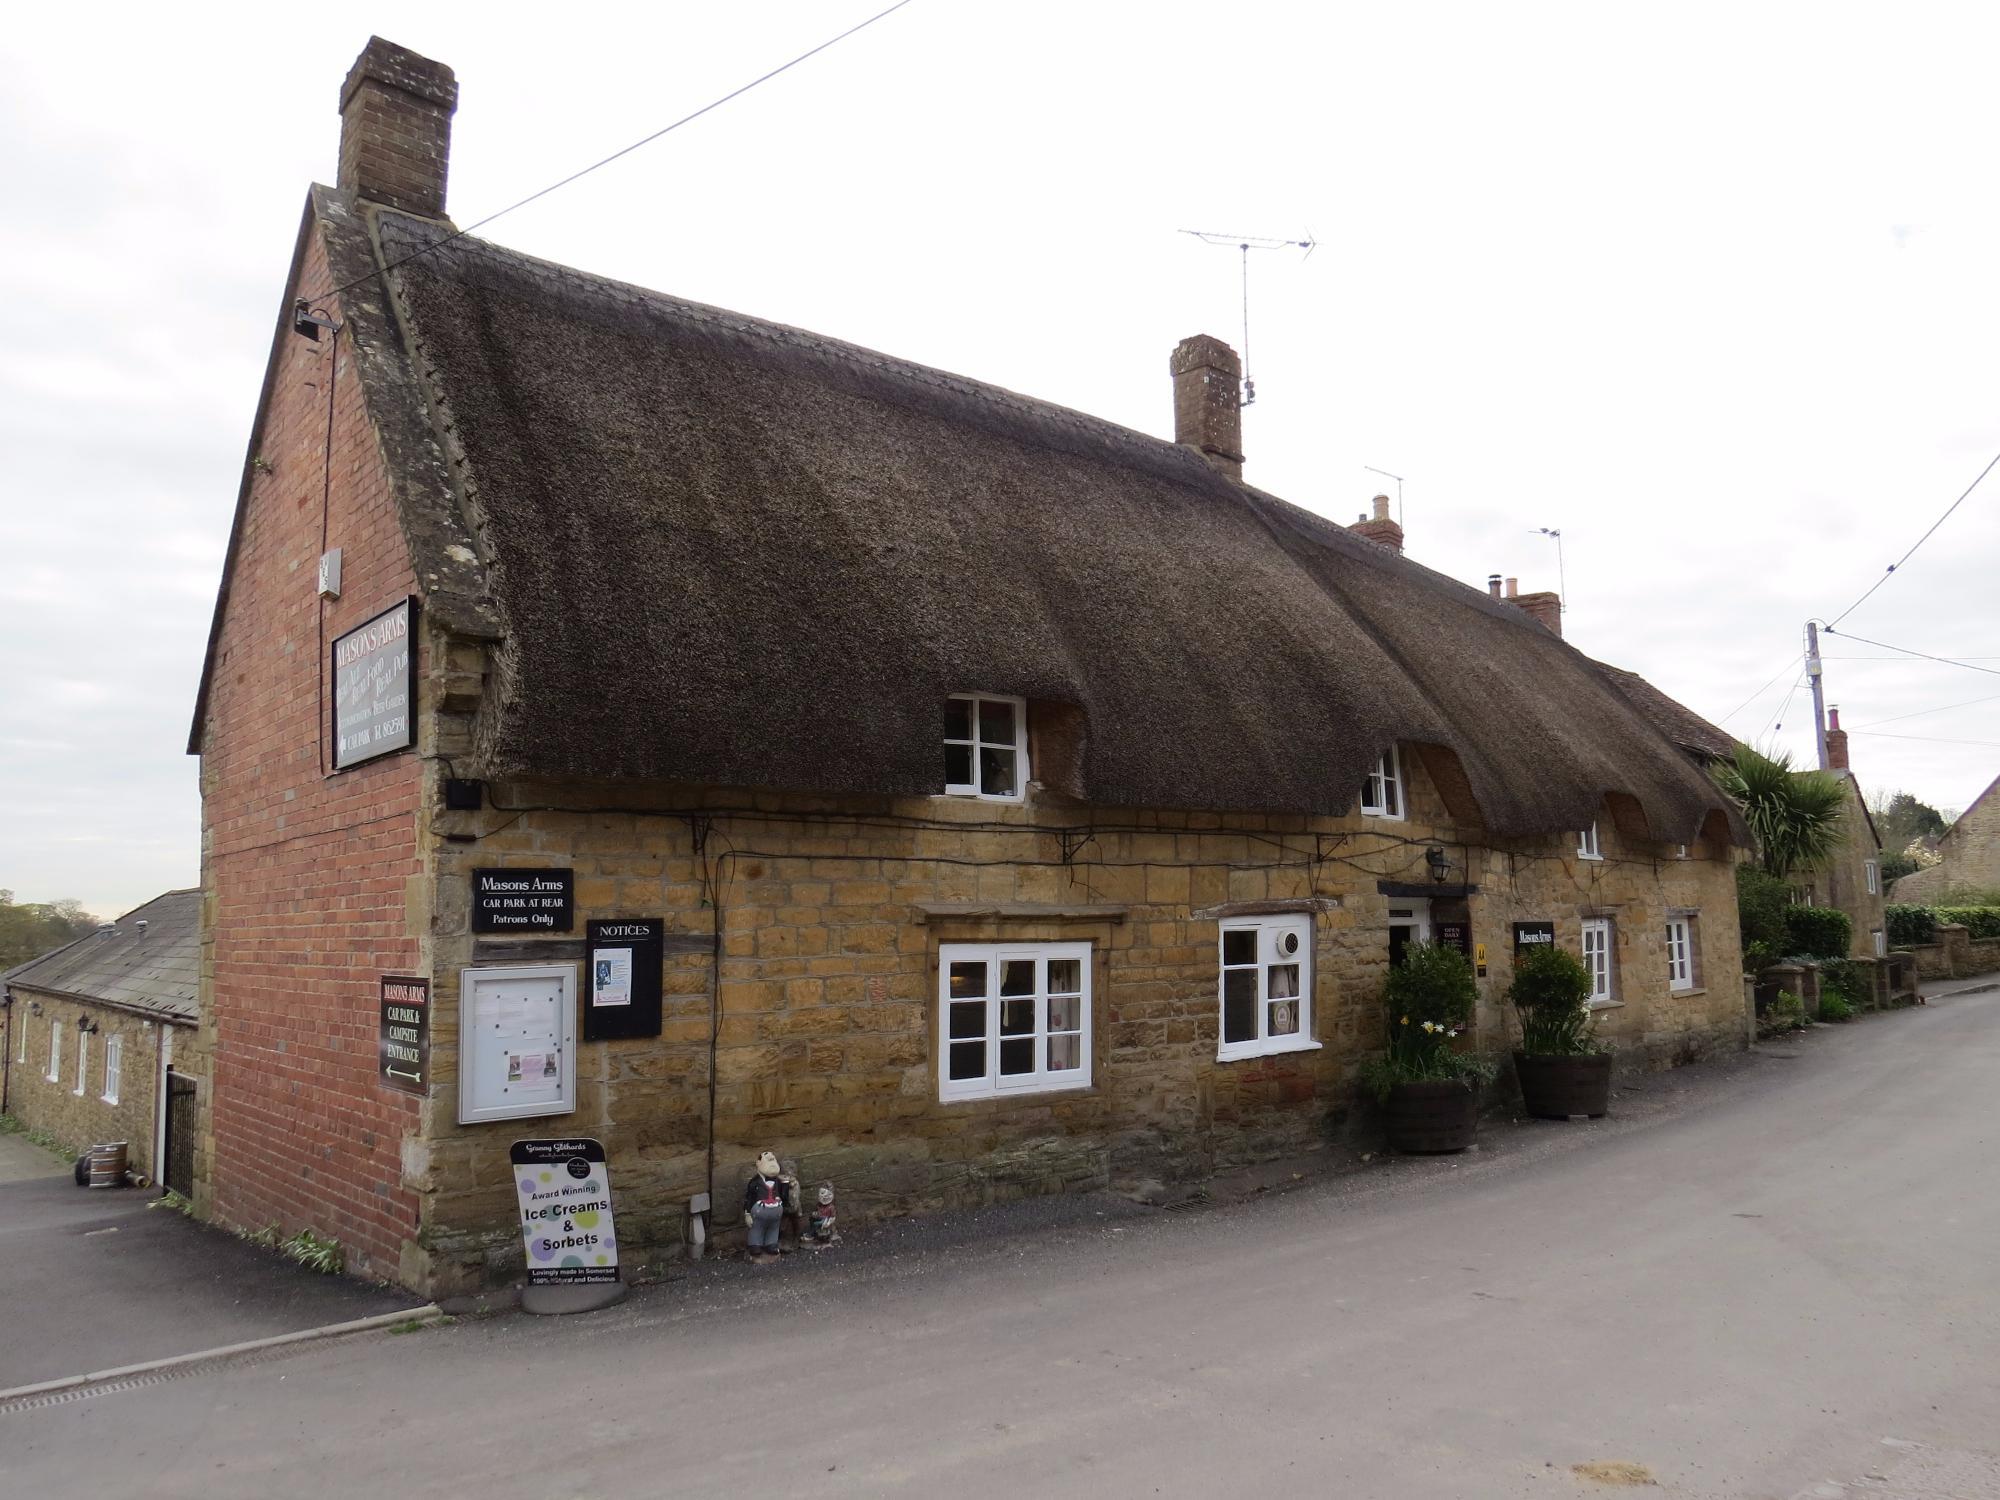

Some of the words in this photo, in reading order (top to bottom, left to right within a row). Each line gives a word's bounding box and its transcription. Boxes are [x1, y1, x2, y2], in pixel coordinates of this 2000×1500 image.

[336, 627, 376, 669] MASONS
[378, 611, 406, 649] ARMS
[481, 877, 529, 890] Masons
[532, 877, 563, 890] Arms
[483, 899, 501, 908] CAR
[503, 899, 526, 908] PARK
[528, 899, 540, 908] AT
[541, 898, 564, 908] REAR
[493, 914, 528, 924] Patrons
[531, 914, 554, 926] Only
[600, 926, 650, 936] NOTICES
[1519, 930, 1539, 943] Masons
[1538, 930, 1552, 943] Arms
[384, 984, 408, 1001] MASONS
[408, 986, 426, 1003] ARMS
[387, 1006, 400, 1021] CAR
[400, 1007, 415, 1023] PARK
[414, 1010, 421, 1024] &
[389, 1025, 419, 1043] CAMPSITE
[387, 1043, 420, 1063] ENTRANCE
[525, 1143, 552, 1153] Granny
[531, 1189, 560, 1201] Award
[561, 1185, 596, 1196] Winning
[525, 1208, 548, 1220] Ice
[552, 1200, 608, 1217] Creams
[563, 1219, 574, 1232] &
[543, 1233, 599, 1251] Sorbets
[532, 1269, 559, 1277] Lovingly
